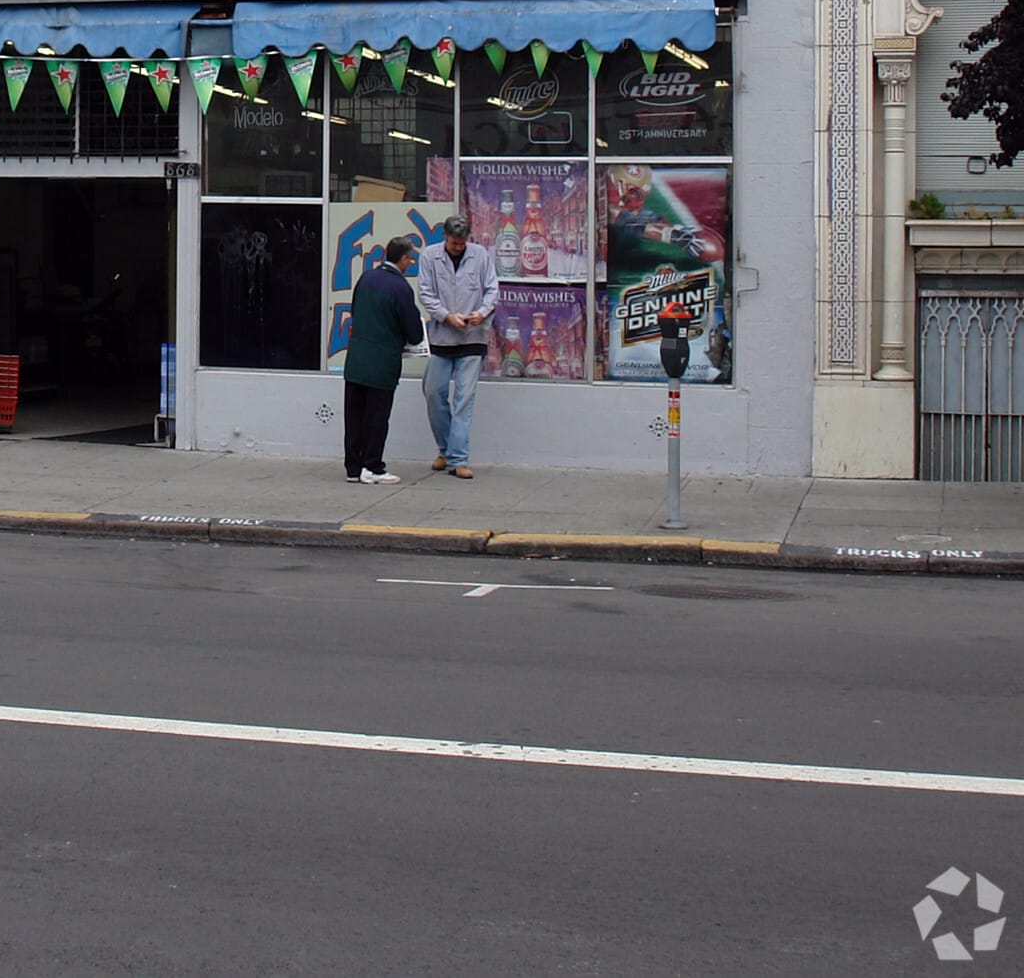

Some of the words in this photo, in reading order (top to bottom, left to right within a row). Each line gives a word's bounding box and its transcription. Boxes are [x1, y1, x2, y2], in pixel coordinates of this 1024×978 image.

[640, 72, 691, 85] BUD
[629, 83, 700, 98] LIGHT
[234, 106, 283, 129] Modelo
[618, 129, 644, 140] 25TH
[644, 128, 707, 140] ANNIVERSARY
[472, 164, 524, 175] HOLIDAY
[525, 164, 570, 175] WISHES
[643, 272, 688, 292] Miller
[498, 290, 530, 302] LIDAY
[532, 292, 576, 303] WISHES
[615, 286, 718, 319] GENUINE
[628, 303, 704, 330] DRT
[140, 514, 211, 523] TRUCKS
[219, 517, 263, 526] ONLY
[834, 547, 921, 559] TRUCKS
[931, 548, 985, 558] ONLY
